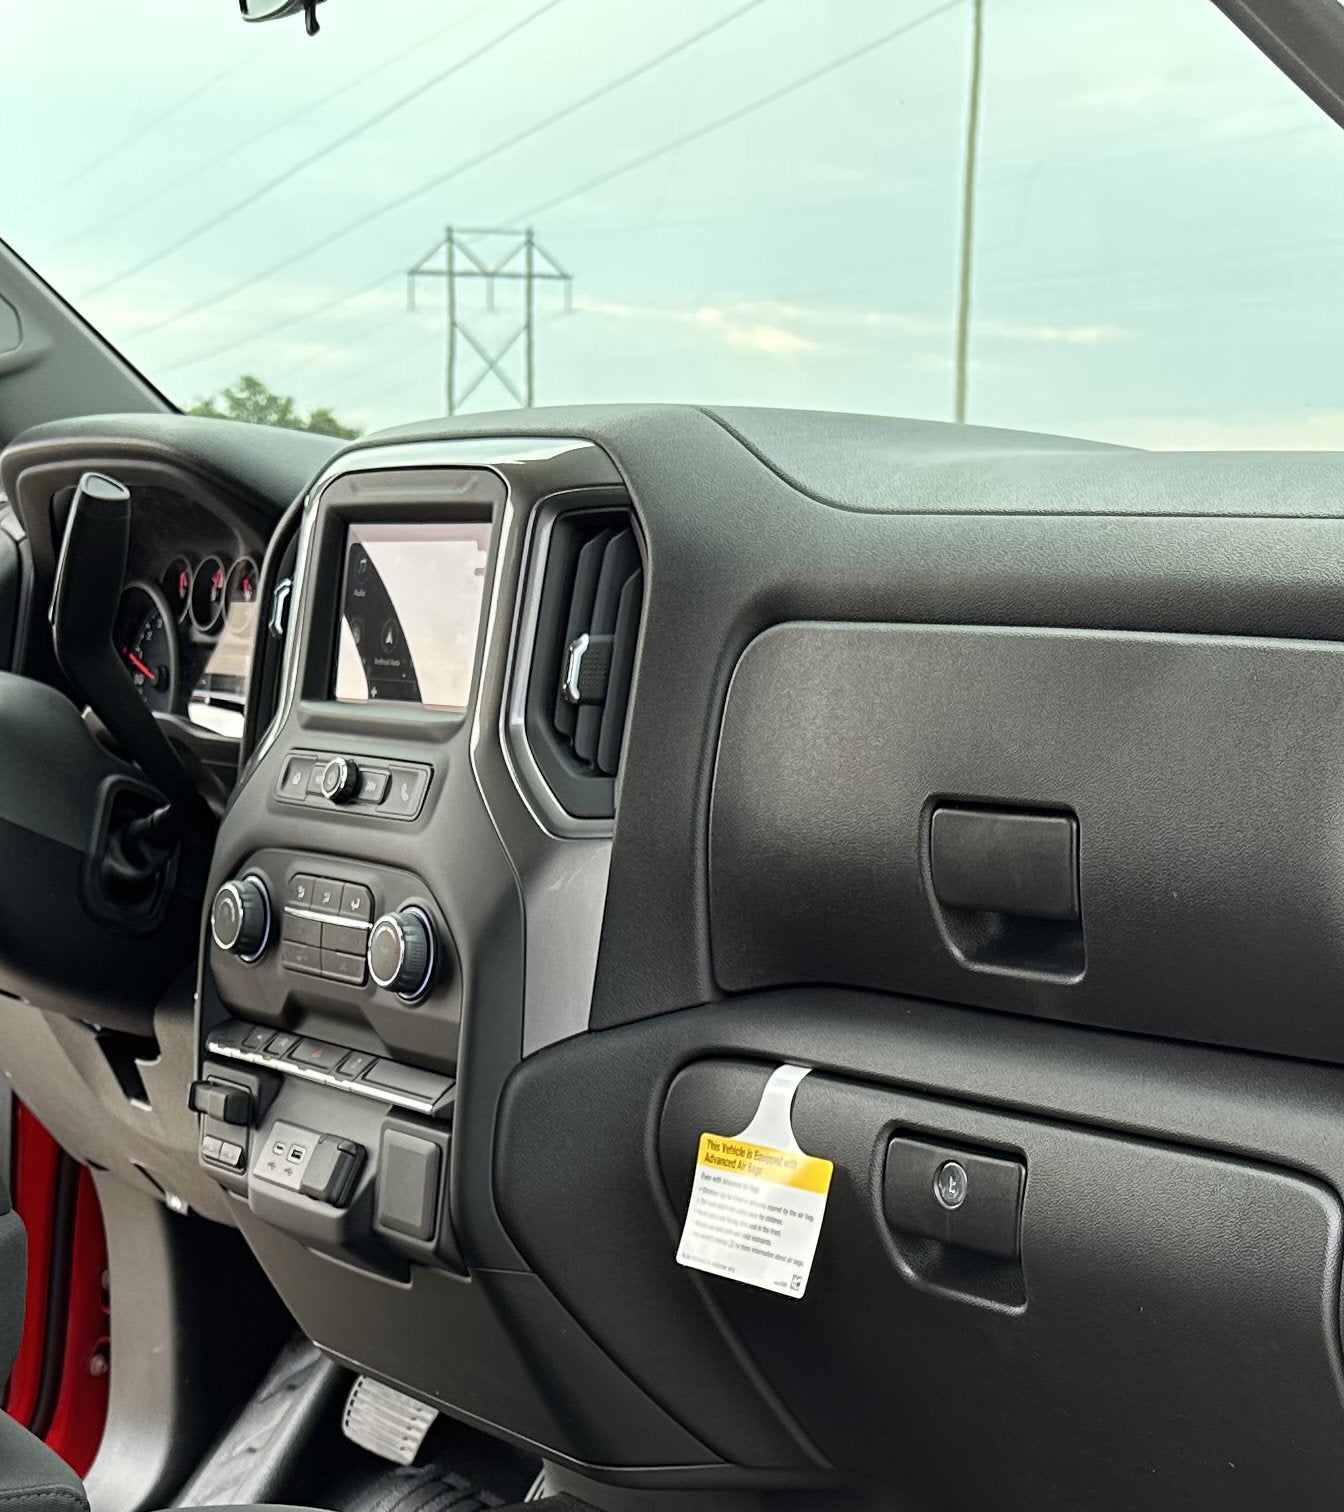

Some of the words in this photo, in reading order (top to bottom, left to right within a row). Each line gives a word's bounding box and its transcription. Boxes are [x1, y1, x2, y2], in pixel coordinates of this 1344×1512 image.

[707, 1139, 721, 1152] This
[722, 1143, 746, 1158] Vehicle
[747, 1147, 753, 1159] is
[704, 1152, 737, 1169] Advanced
